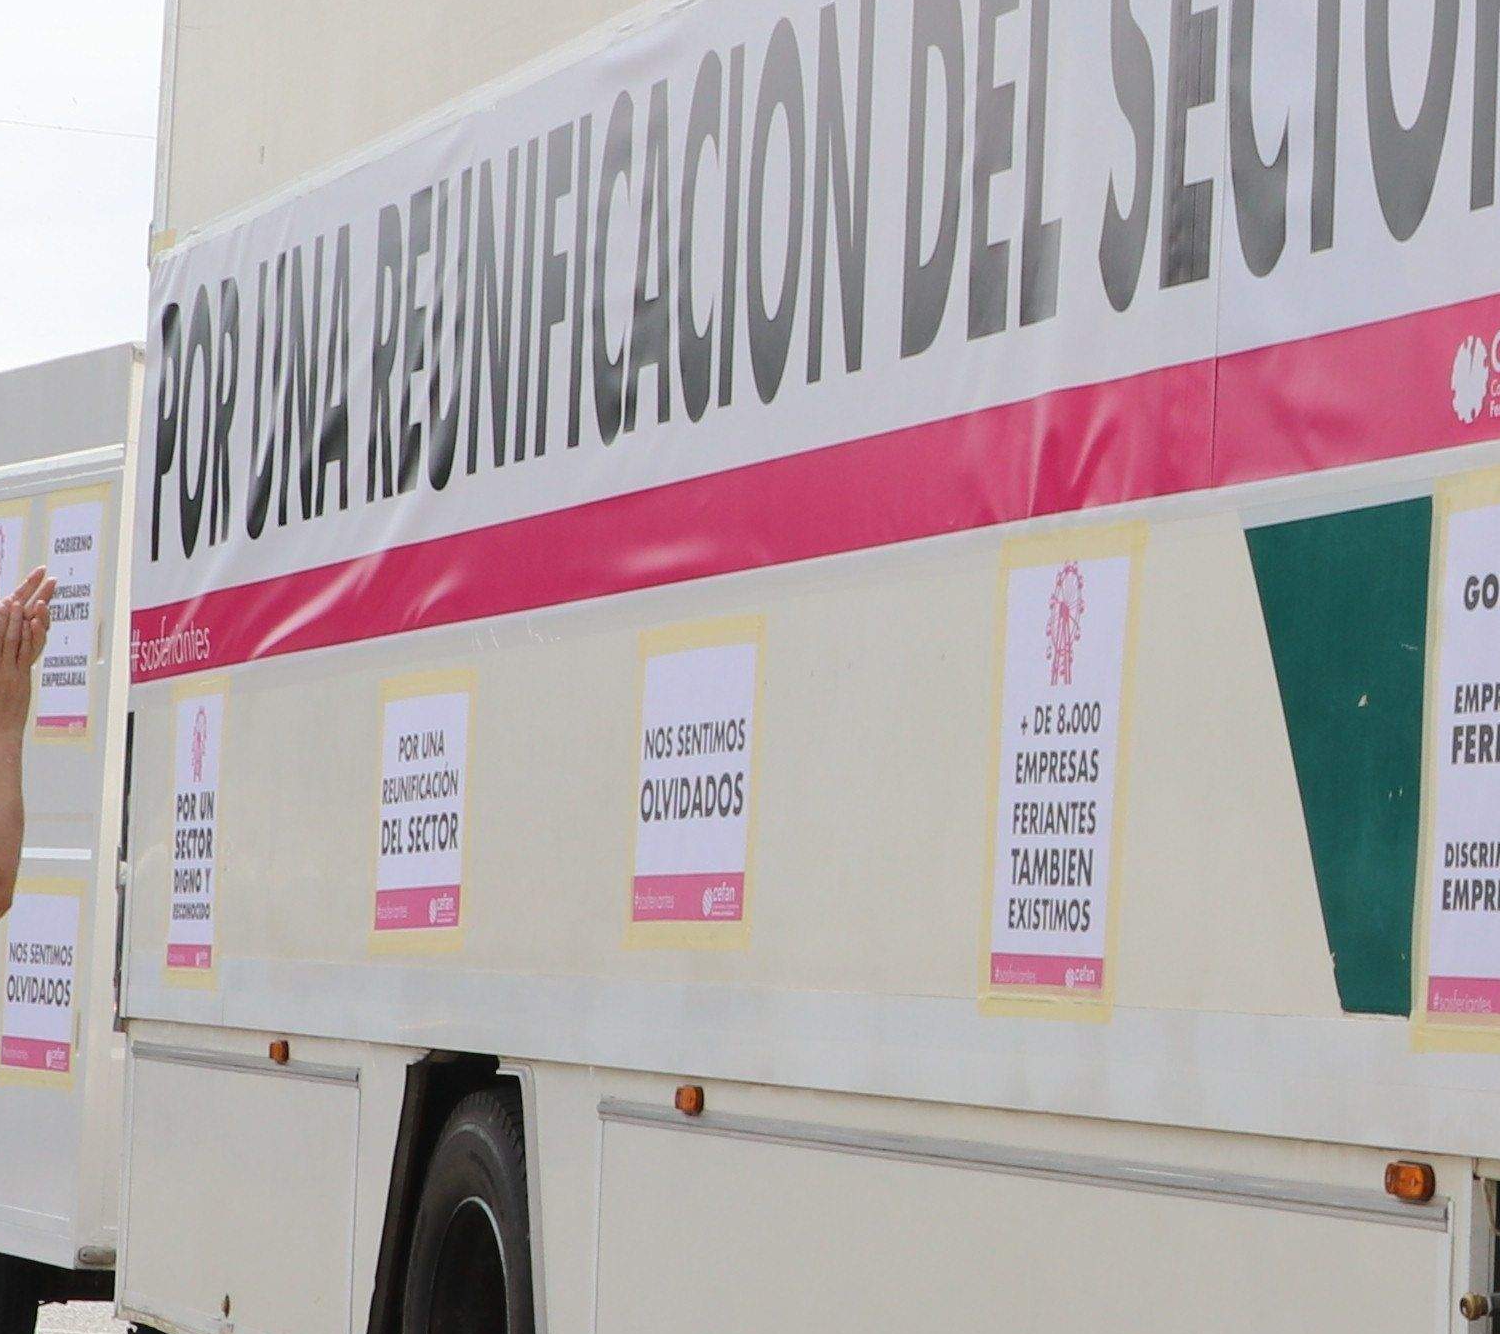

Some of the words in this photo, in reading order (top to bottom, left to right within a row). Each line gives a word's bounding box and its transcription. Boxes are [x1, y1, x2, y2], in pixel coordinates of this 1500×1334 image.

[151, 278, 239, 563] POR
[245, 224, 350, 542] UNA
[54, 534, 93, 554] GOBIERNO
[1034, 705, 1052, 736] DE
[1057, 701, 1100, 735] 8.000
[398, 733, 419, 762] POR
[422, 729, 445, 759] UNA
[644, 726, 673, 760] NOS
[677, 718, 746, 757] SENTIMOS
[382, 762, 459, 805] REUNIFICACIÓN
[1015, 749, 1099, 785] EMPRESAS
[176, 793, 197, 822] POR
[199, 790, 215, 820] UN
[640, 770, 744, 823] OLVIDADOS
[381, 818, 403, 856] DEL
[407, 812, 458, 852] SECTOR
[1012, 801, 1096, 836] FERIANTES
[174, 827, 214, 860] SECTOR
[173, 869, 201, 894] DIGNO
[202, 867, 211, 893] Y
[1011, 848, 1093, 887] TAMBIEN
[1008, 897, 1090, 933] EXISTIMOS
[9, 942, 28, 964] NOS
[29, 944, 73, 966] SENTIMOS
[6, 974, 71, 1007] OLVIDADOS
